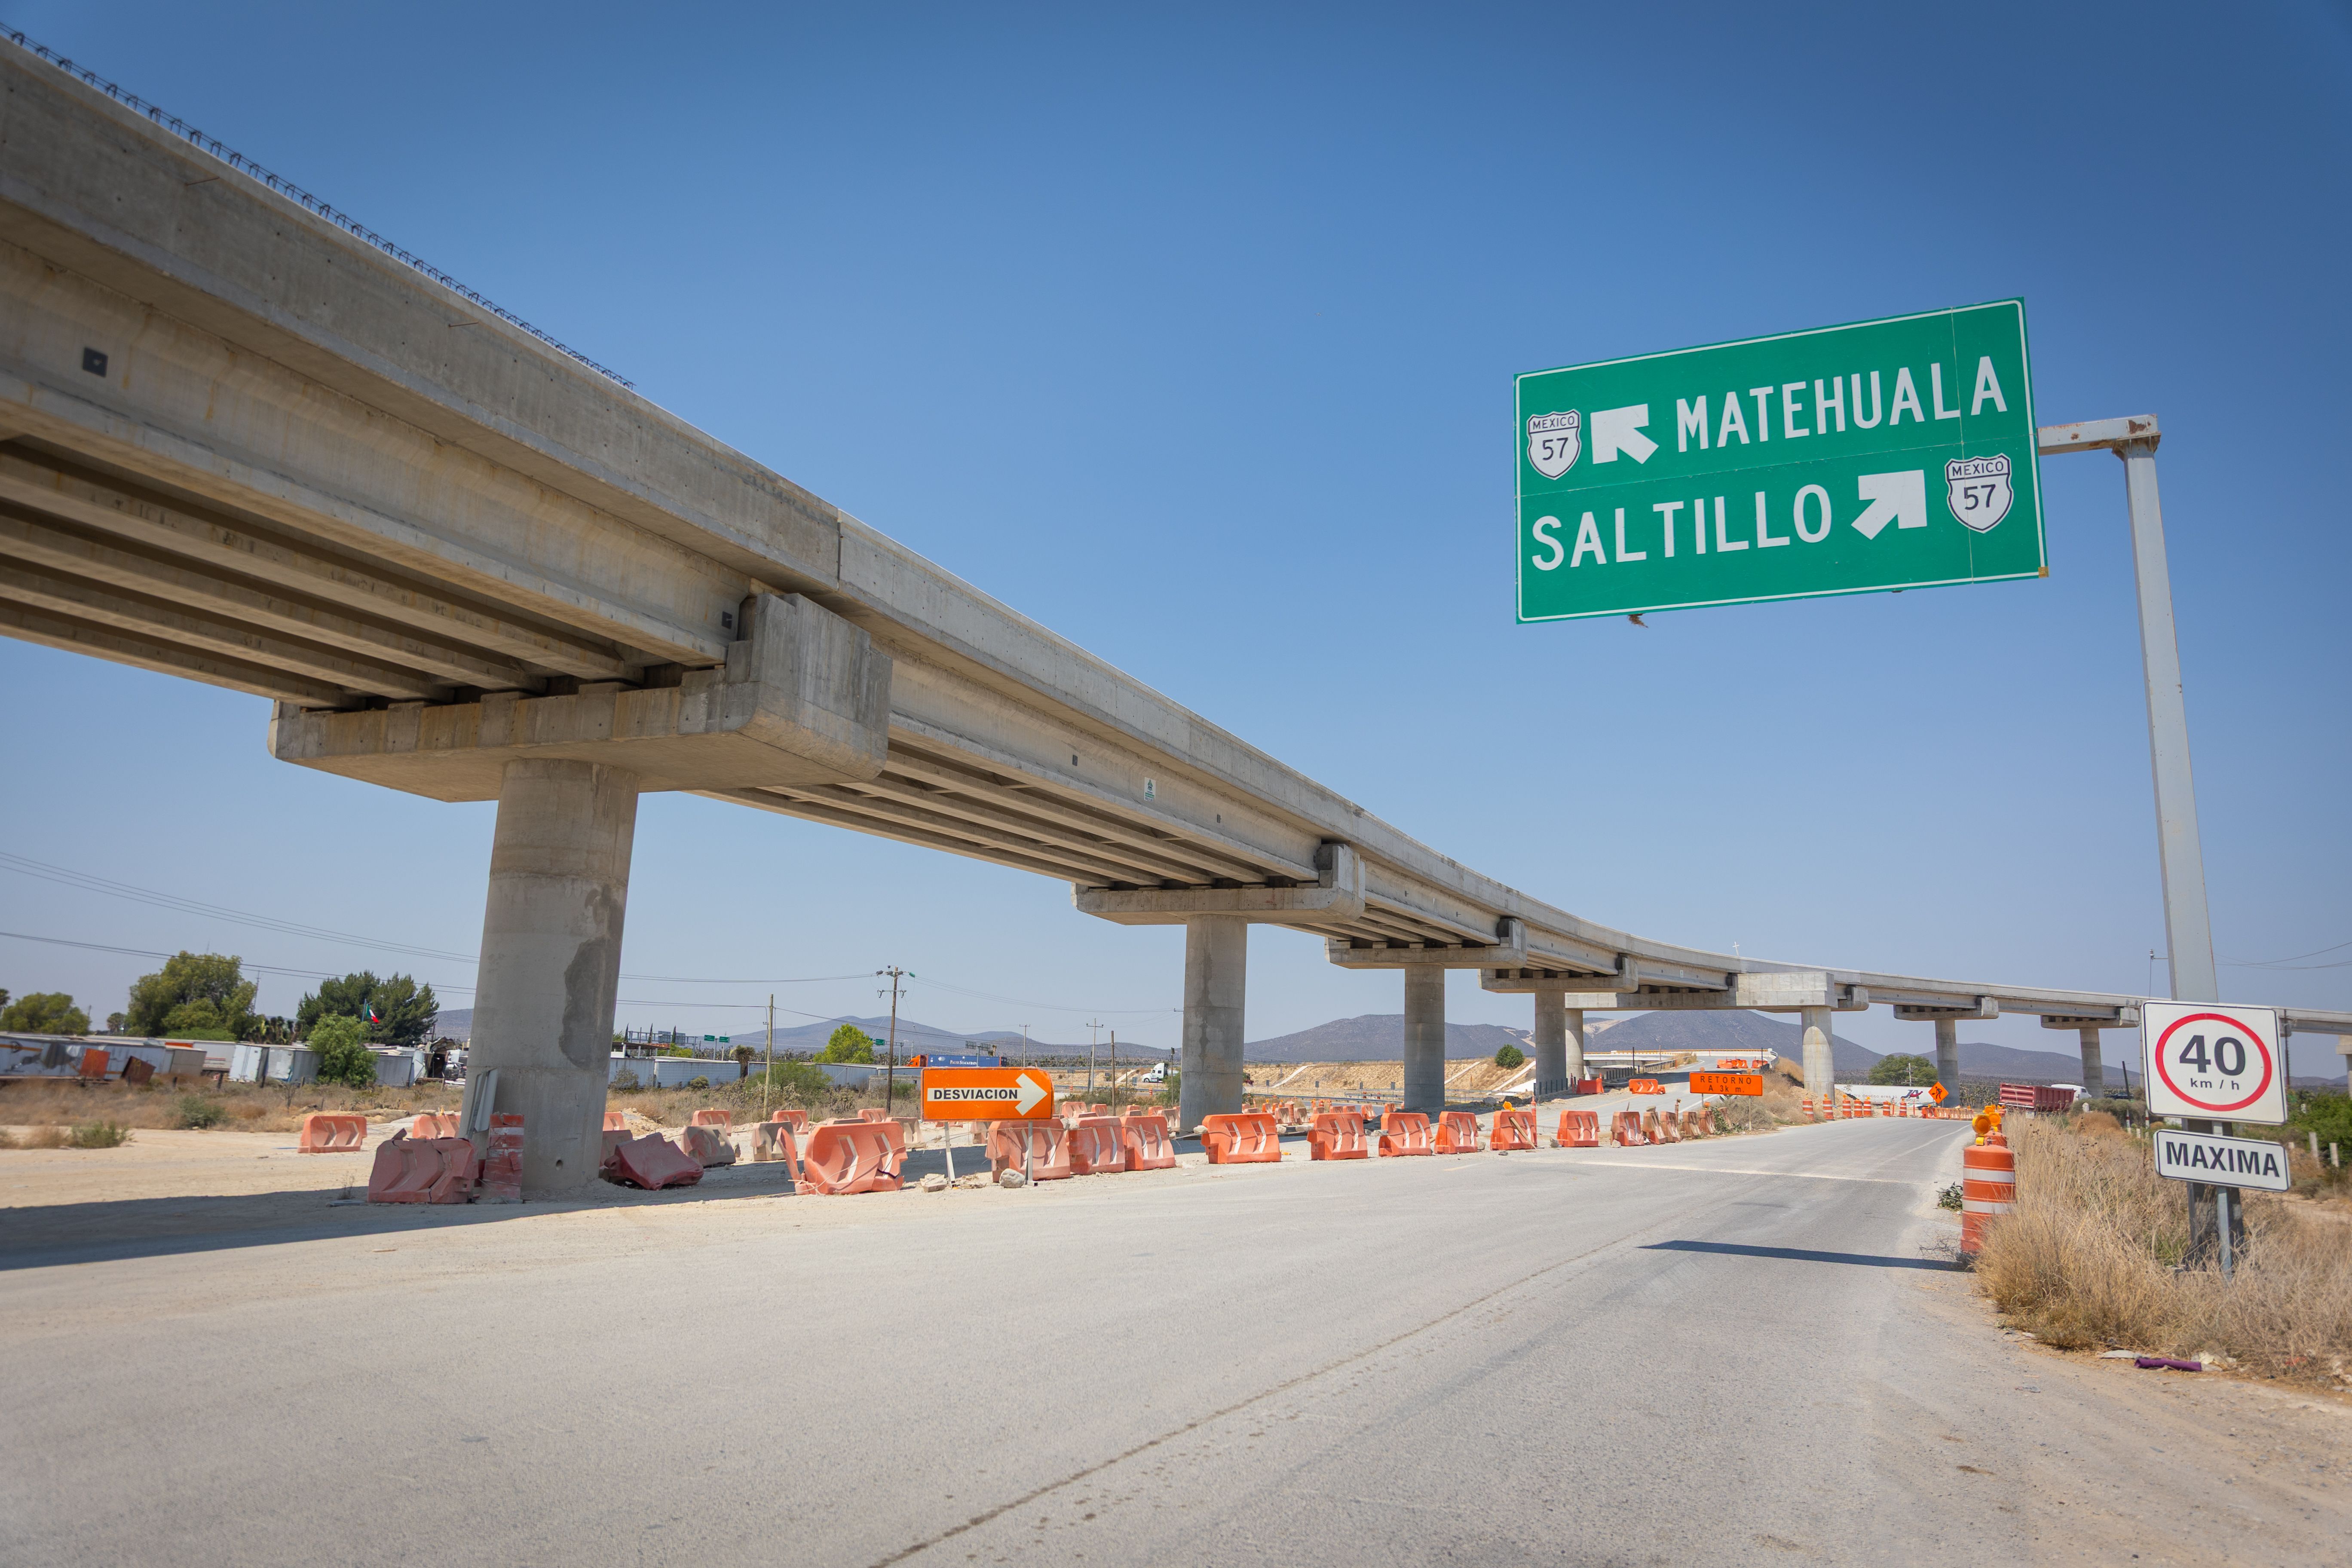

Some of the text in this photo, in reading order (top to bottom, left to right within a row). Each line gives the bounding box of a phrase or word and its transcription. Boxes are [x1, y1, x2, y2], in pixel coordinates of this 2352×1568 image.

[1677, 355, 2008, 453] MATEHUALA
[1533, 416, 1575, 430] MEXICO
[1542, 437, 1568, 461] 57
[1952, 461, 2004, 477] MEXICO
[1964, 484, 1996, 510] 57
[1532, 484, 1832, 571] SALTILLO
[2179, 1035, 2246, 1076] 40
[1700, 1076, 1752, 1084] RETORNO
[934, 1089, 1018, 1099] DESVIACION
[2166, 1142, 2280, 1178] MAXIMA
